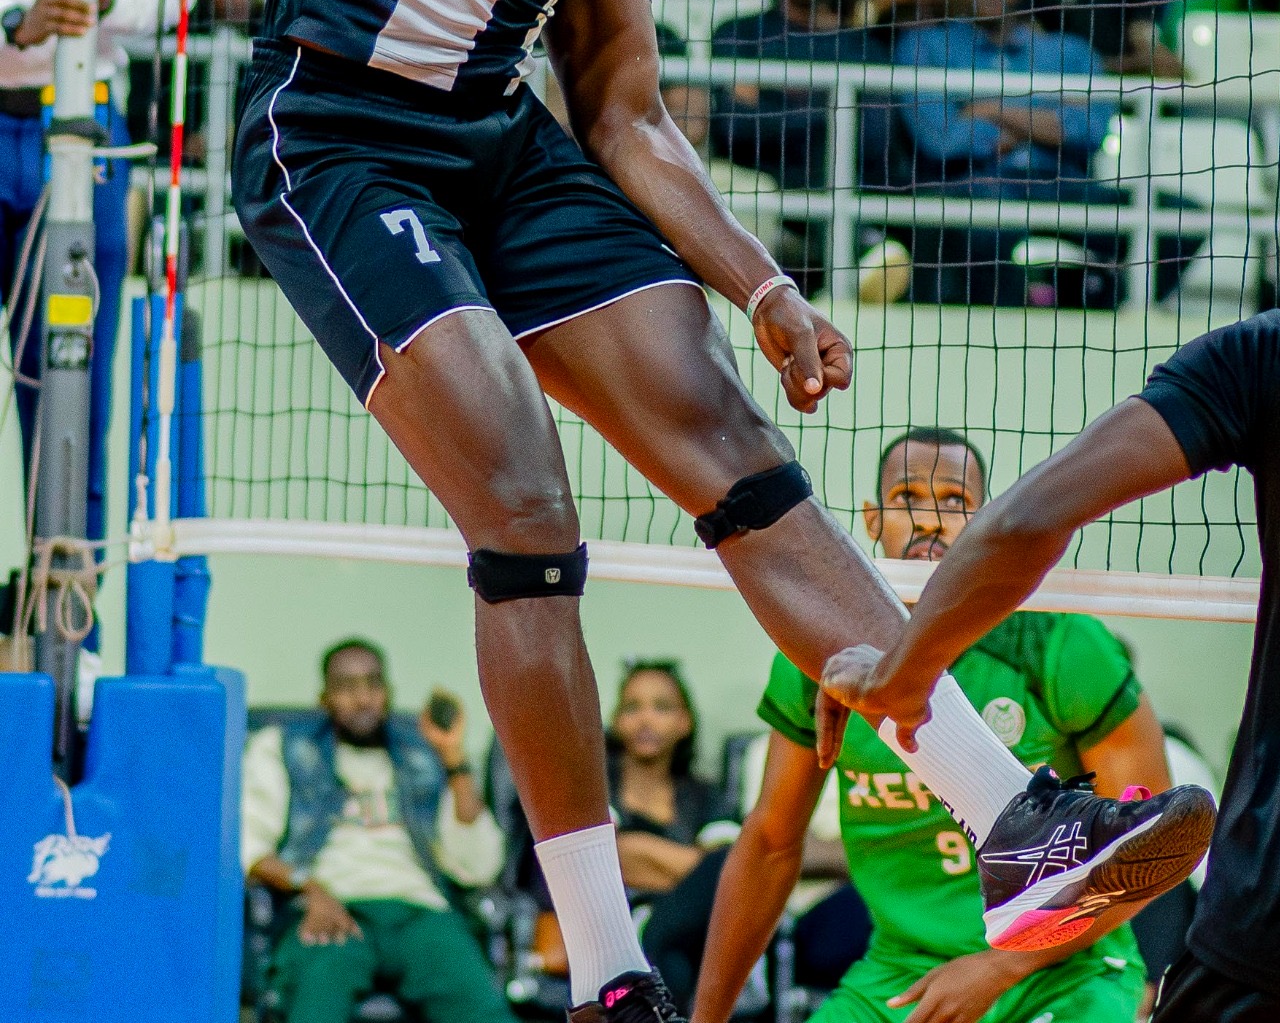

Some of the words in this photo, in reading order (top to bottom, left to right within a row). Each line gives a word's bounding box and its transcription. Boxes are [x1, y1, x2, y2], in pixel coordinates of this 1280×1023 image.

[380, 209, 441, 264] 7
[754, 280, 774, 299] PUMA
[936, 831, 971, 875] 9
